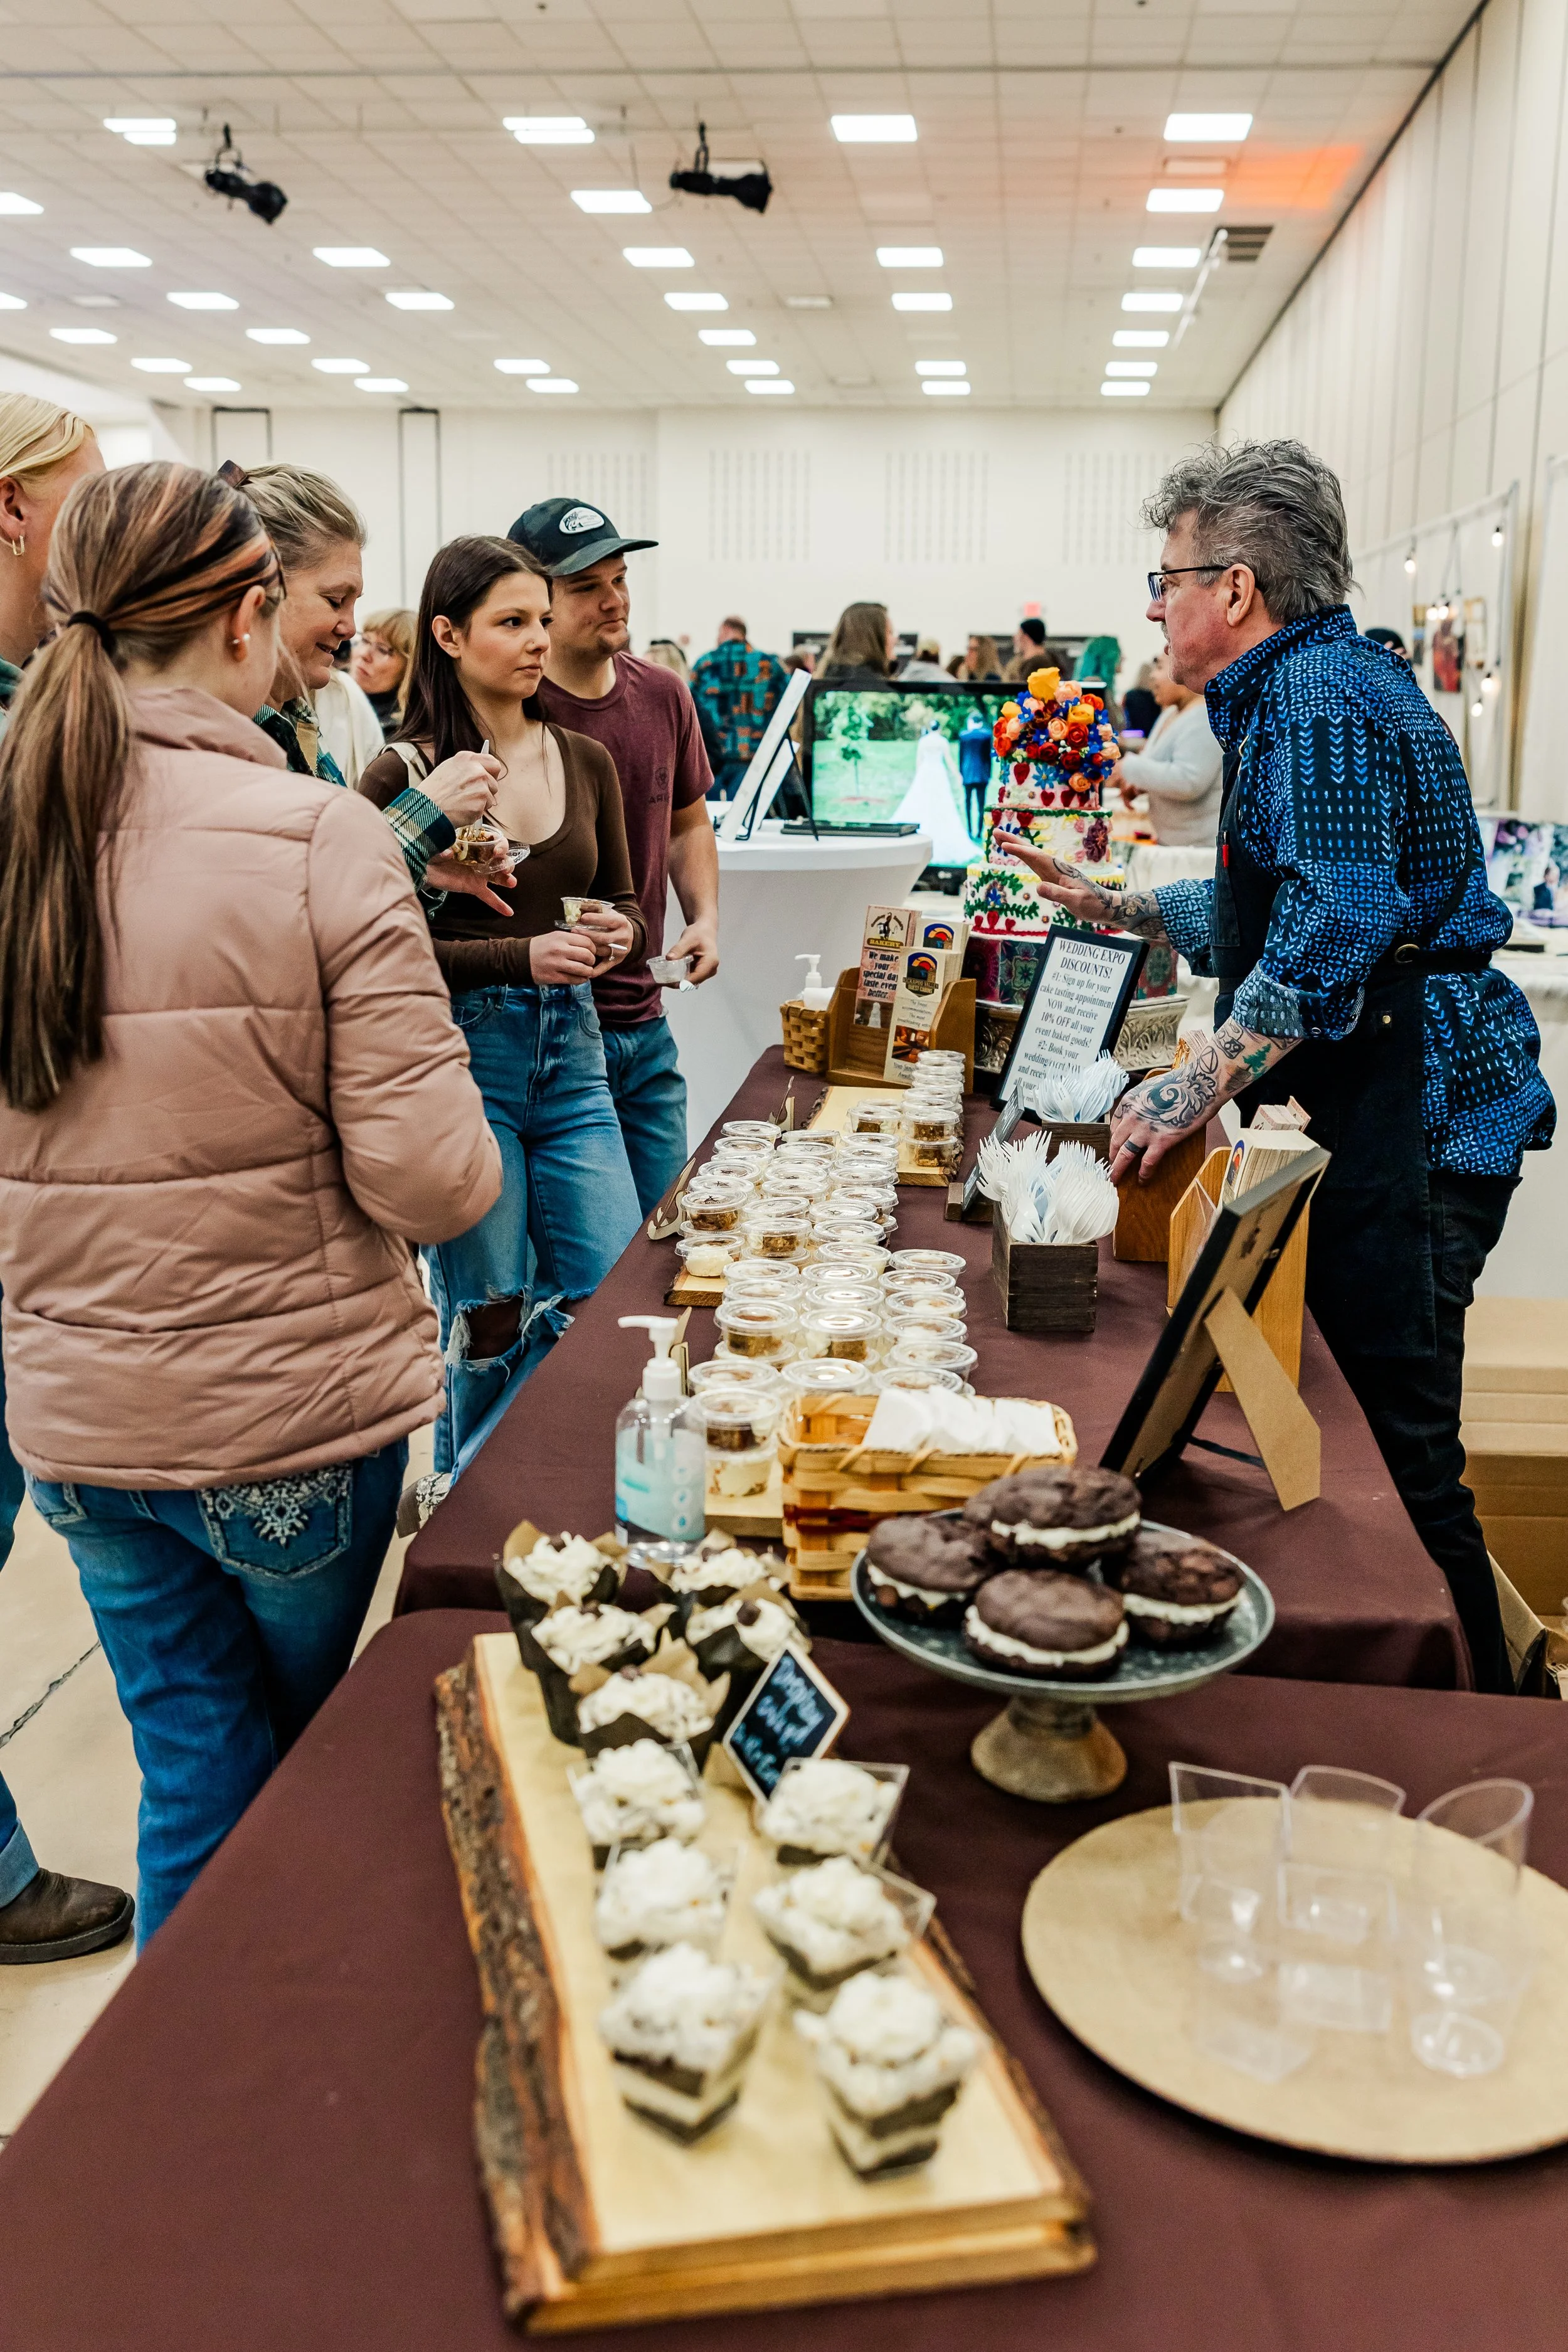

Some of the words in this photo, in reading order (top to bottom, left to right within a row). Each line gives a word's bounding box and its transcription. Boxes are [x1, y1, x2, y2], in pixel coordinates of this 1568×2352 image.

[869, 939, 901, 947] BAKERY
[869, 951, 878, 960] We
[879, 953, 899, 962] make
[1059, 940, 1100, 959] WEDDING
[1101, 950, 1125, 965] EXPO
[874, 962, 889, 970] your
[1060, 957, 1113, 979] DISCOUNTS!
[863, 970, 886, 979] special
[1052, 972, 1062, 982] #1:
[1062, 973, 1075, 986] Sign
[1076, 979, 1085, 990] up
[1086, 979, 1096, 988] for
[1094, 984, 1111, 993] your
[863, 978, 879, 988] taste
[880, 983, 898, 991] even
[867, 988, 888, 999] better.
[1040, 984, 1054, 993] cake
[1054, 987, 1074, 1000] tasting
[1075, 993, 1114, 1009] appointment
[1047, 999, 1063, 1010] NOW
[1064, 1005, 1077, 1014] and
[1077, 1009, 1098, 1020] receive
[1041, 1012, 1055, 1024] 10%
[1056, 1015, 1071, 1027] OFF
[1071, 1020, 1079, 1030] all
[1078, 1025, 1094, 1034] your
[1035, 1027, 1051, 1036] event
[1052, 1029, 1071, 1042] baked
[1069, 1037, 1091, 1047] goods!
[1038, 1040, 1047, 1050] #2:
[1048, 1042, 1064, 1056] Book
[1063, 1050, 1079, 1059] your
[1017, 1065, 1030, 1074] and
[1013, 1078, 1022, 1086] all
[1022, 1082, 1037, 1090] your
